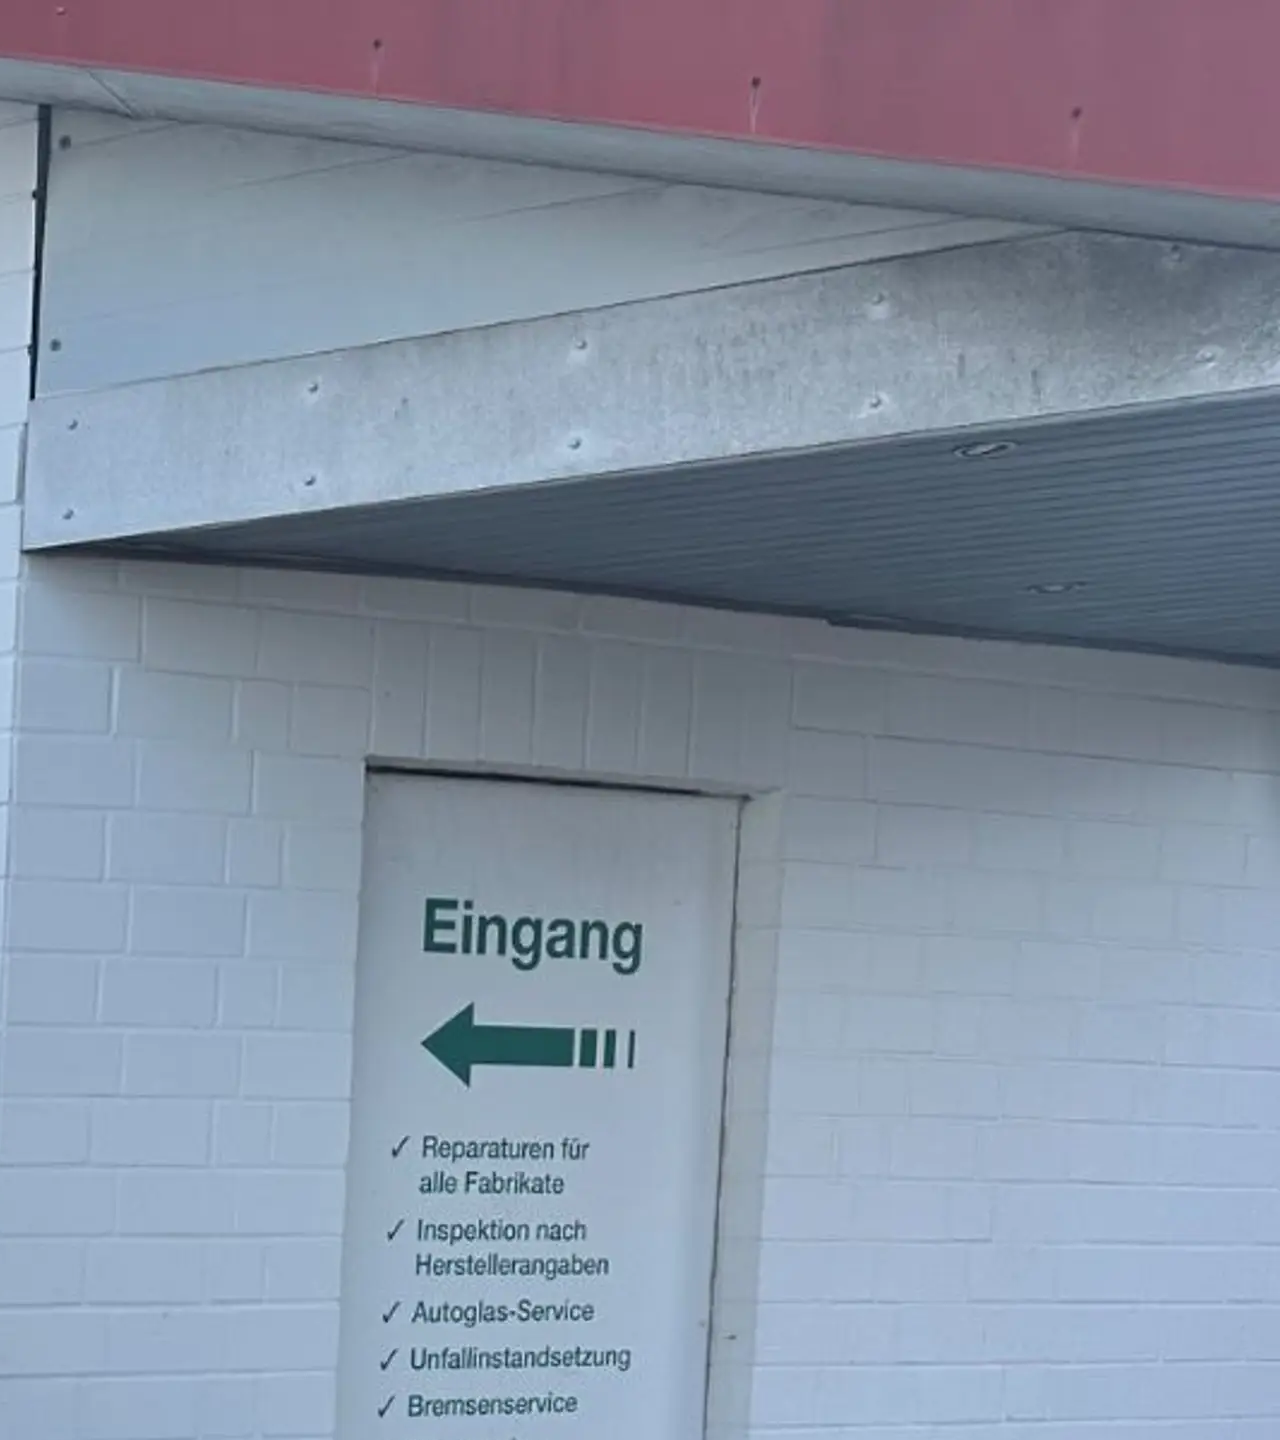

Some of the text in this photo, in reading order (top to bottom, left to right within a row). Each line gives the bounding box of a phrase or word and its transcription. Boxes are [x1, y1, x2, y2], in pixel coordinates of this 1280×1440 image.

[423, 898, 643, 975] Eingang
[421, 1135, 589, 1163] Reparaturen für
[419, 1171, 565, 1195] alle Fabrikate
[417, 1219, 587, 1245] Inspektion nach
[415, 1254, 609, 1280] Herstellerangaben
[411, 1300, 595, 1327] Autoglas-Service
[410, 1347, 631, 1371] Unfallinstandsetzung
[407, 1393, 578, 1417] Bremsenservice
